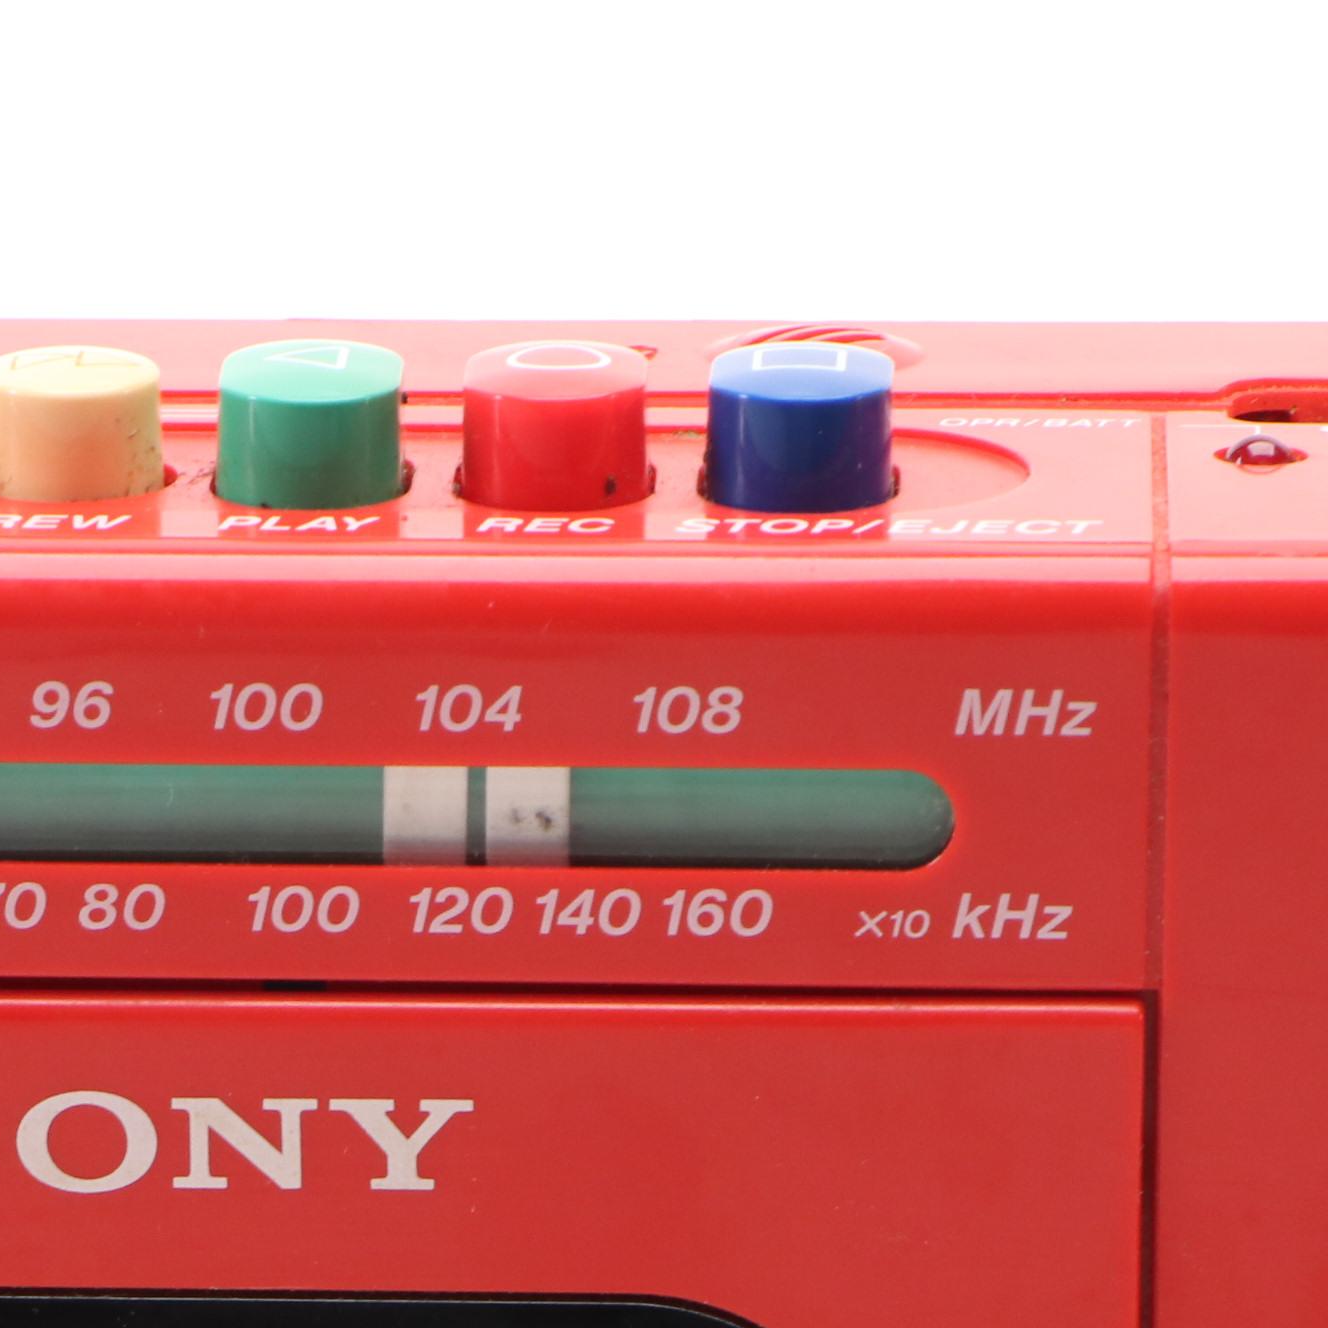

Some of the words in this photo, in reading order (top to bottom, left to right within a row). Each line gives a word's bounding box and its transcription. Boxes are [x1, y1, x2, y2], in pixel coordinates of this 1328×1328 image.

[938, 416, 1143, 429] OPR/BATT
[218, 514, 381, 533] PLAY
[476, 515, 616, 534] REC
[675, 516, 1104, 537] STOP/EJECT
[30, 682, 114, 729] 96
[210, 683, 323, 731] 100
[415, 685, 522, 732] 104
[633, 687, 744, 734] 108
[955, 689, 1097, 737] MHz
[78, 884, 166, 931] 80
[248, 886, 360, 933] 100
[409, 887, 514, 935] 120
[535, 889, 642, 937] 140
[662, 889, 773, 937] 160
[952, 893, 1073, 940] kHz
